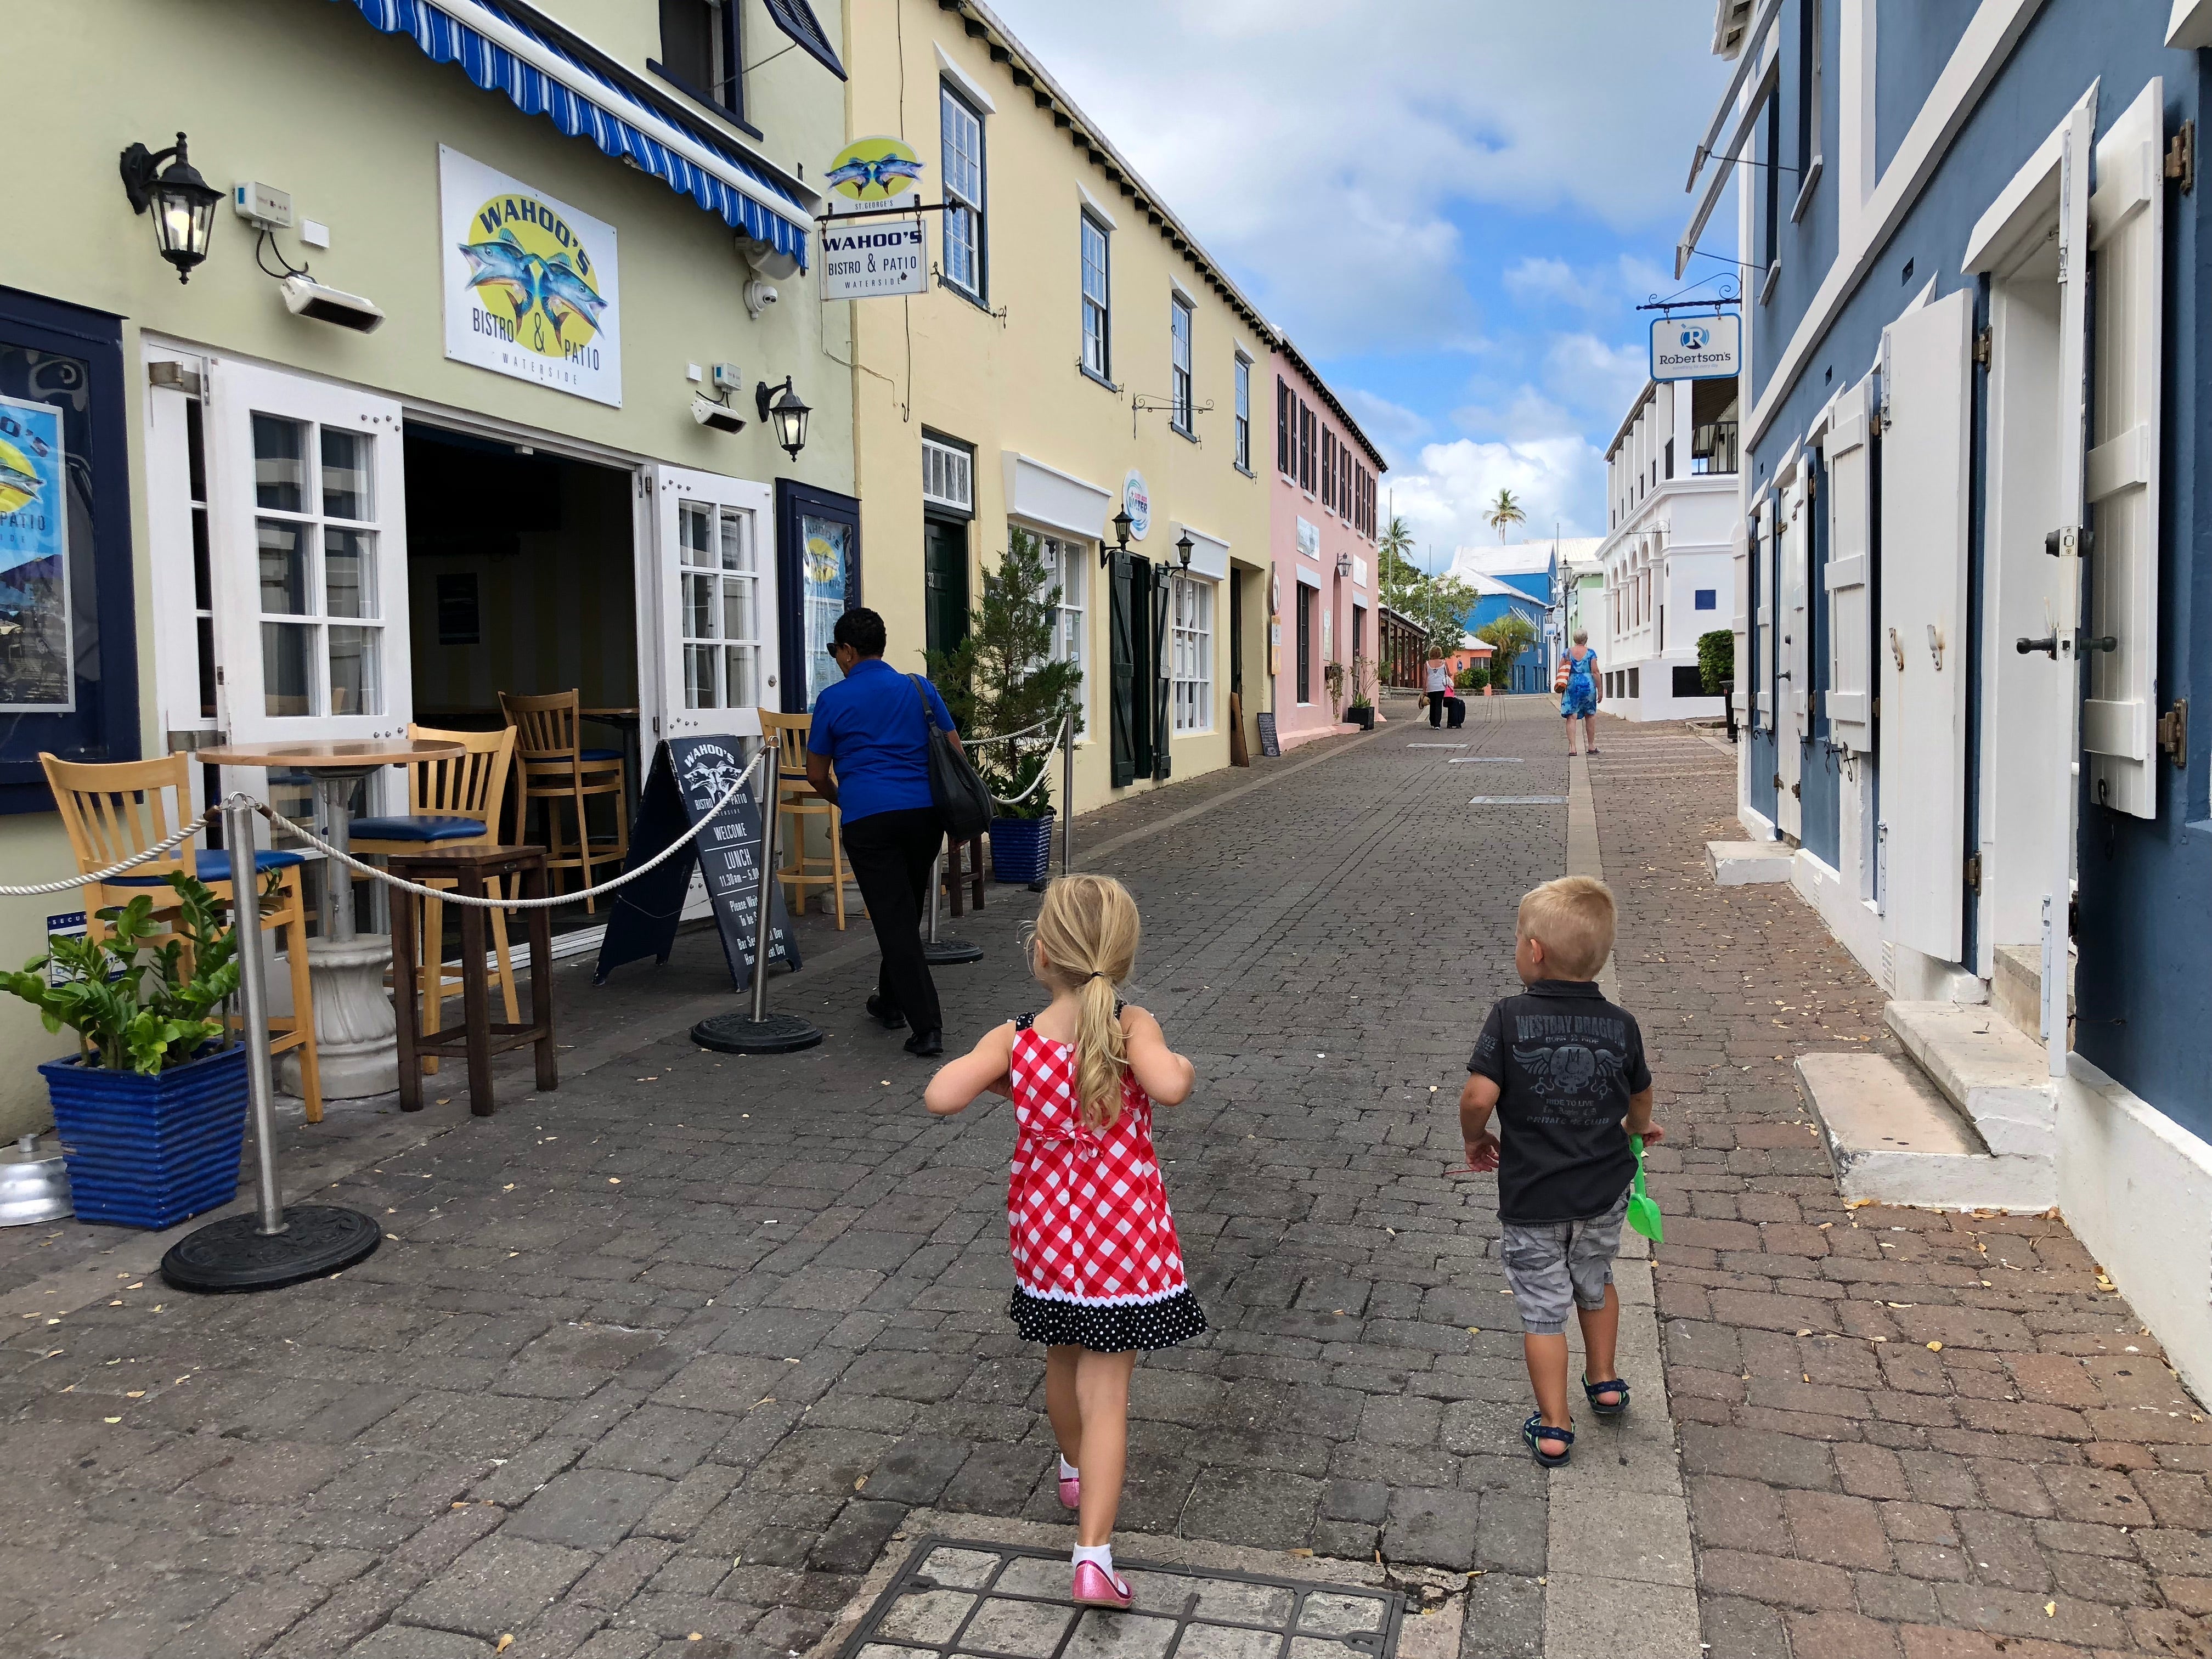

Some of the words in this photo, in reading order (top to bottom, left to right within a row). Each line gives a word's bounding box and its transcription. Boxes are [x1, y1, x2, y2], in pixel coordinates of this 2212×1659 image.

[479, 199, 590, 276] WAHOO'S
[822, 230, 922, 252] WAHOO'S
[828, 261, 861, 276] BISTRO
[867, 253, 877, 273] &
[883, 256, 917, 272] PATIO
[845, 278, 901, 289] WATERSIDE
[473, 307, 515, 343] BISTRO
[534, 312, 546, 353] &
[565, 338, 600, 371] PATIO
[502, 352, 578, 385] WATERSIDE
[1660, 352, 1731, 365] Robertson's
[1129, 496, 1148, 515] WATER
[808, 524, 841, 551] AHOO'S
[684, 743, 735, 768] WAHOO'S
[694, 798, 714, 811] BISTRO
[730, 793, 748, 805] PATIO
[713, 822, 748, 841] WELCOME
[724, 848, 753, 870] LUNCH
[719, 873, 742, 887] 11.30am
[729, 900, 747, 912] Please
[739, 915, 747, 927] To
[746, 913, 754, 925] be
[737, 938, 747, 950] Bar
[772, 927, 783, 940] Day
[744, 953, 755, 966] Hav
[775, 944, 786, 956] Day
